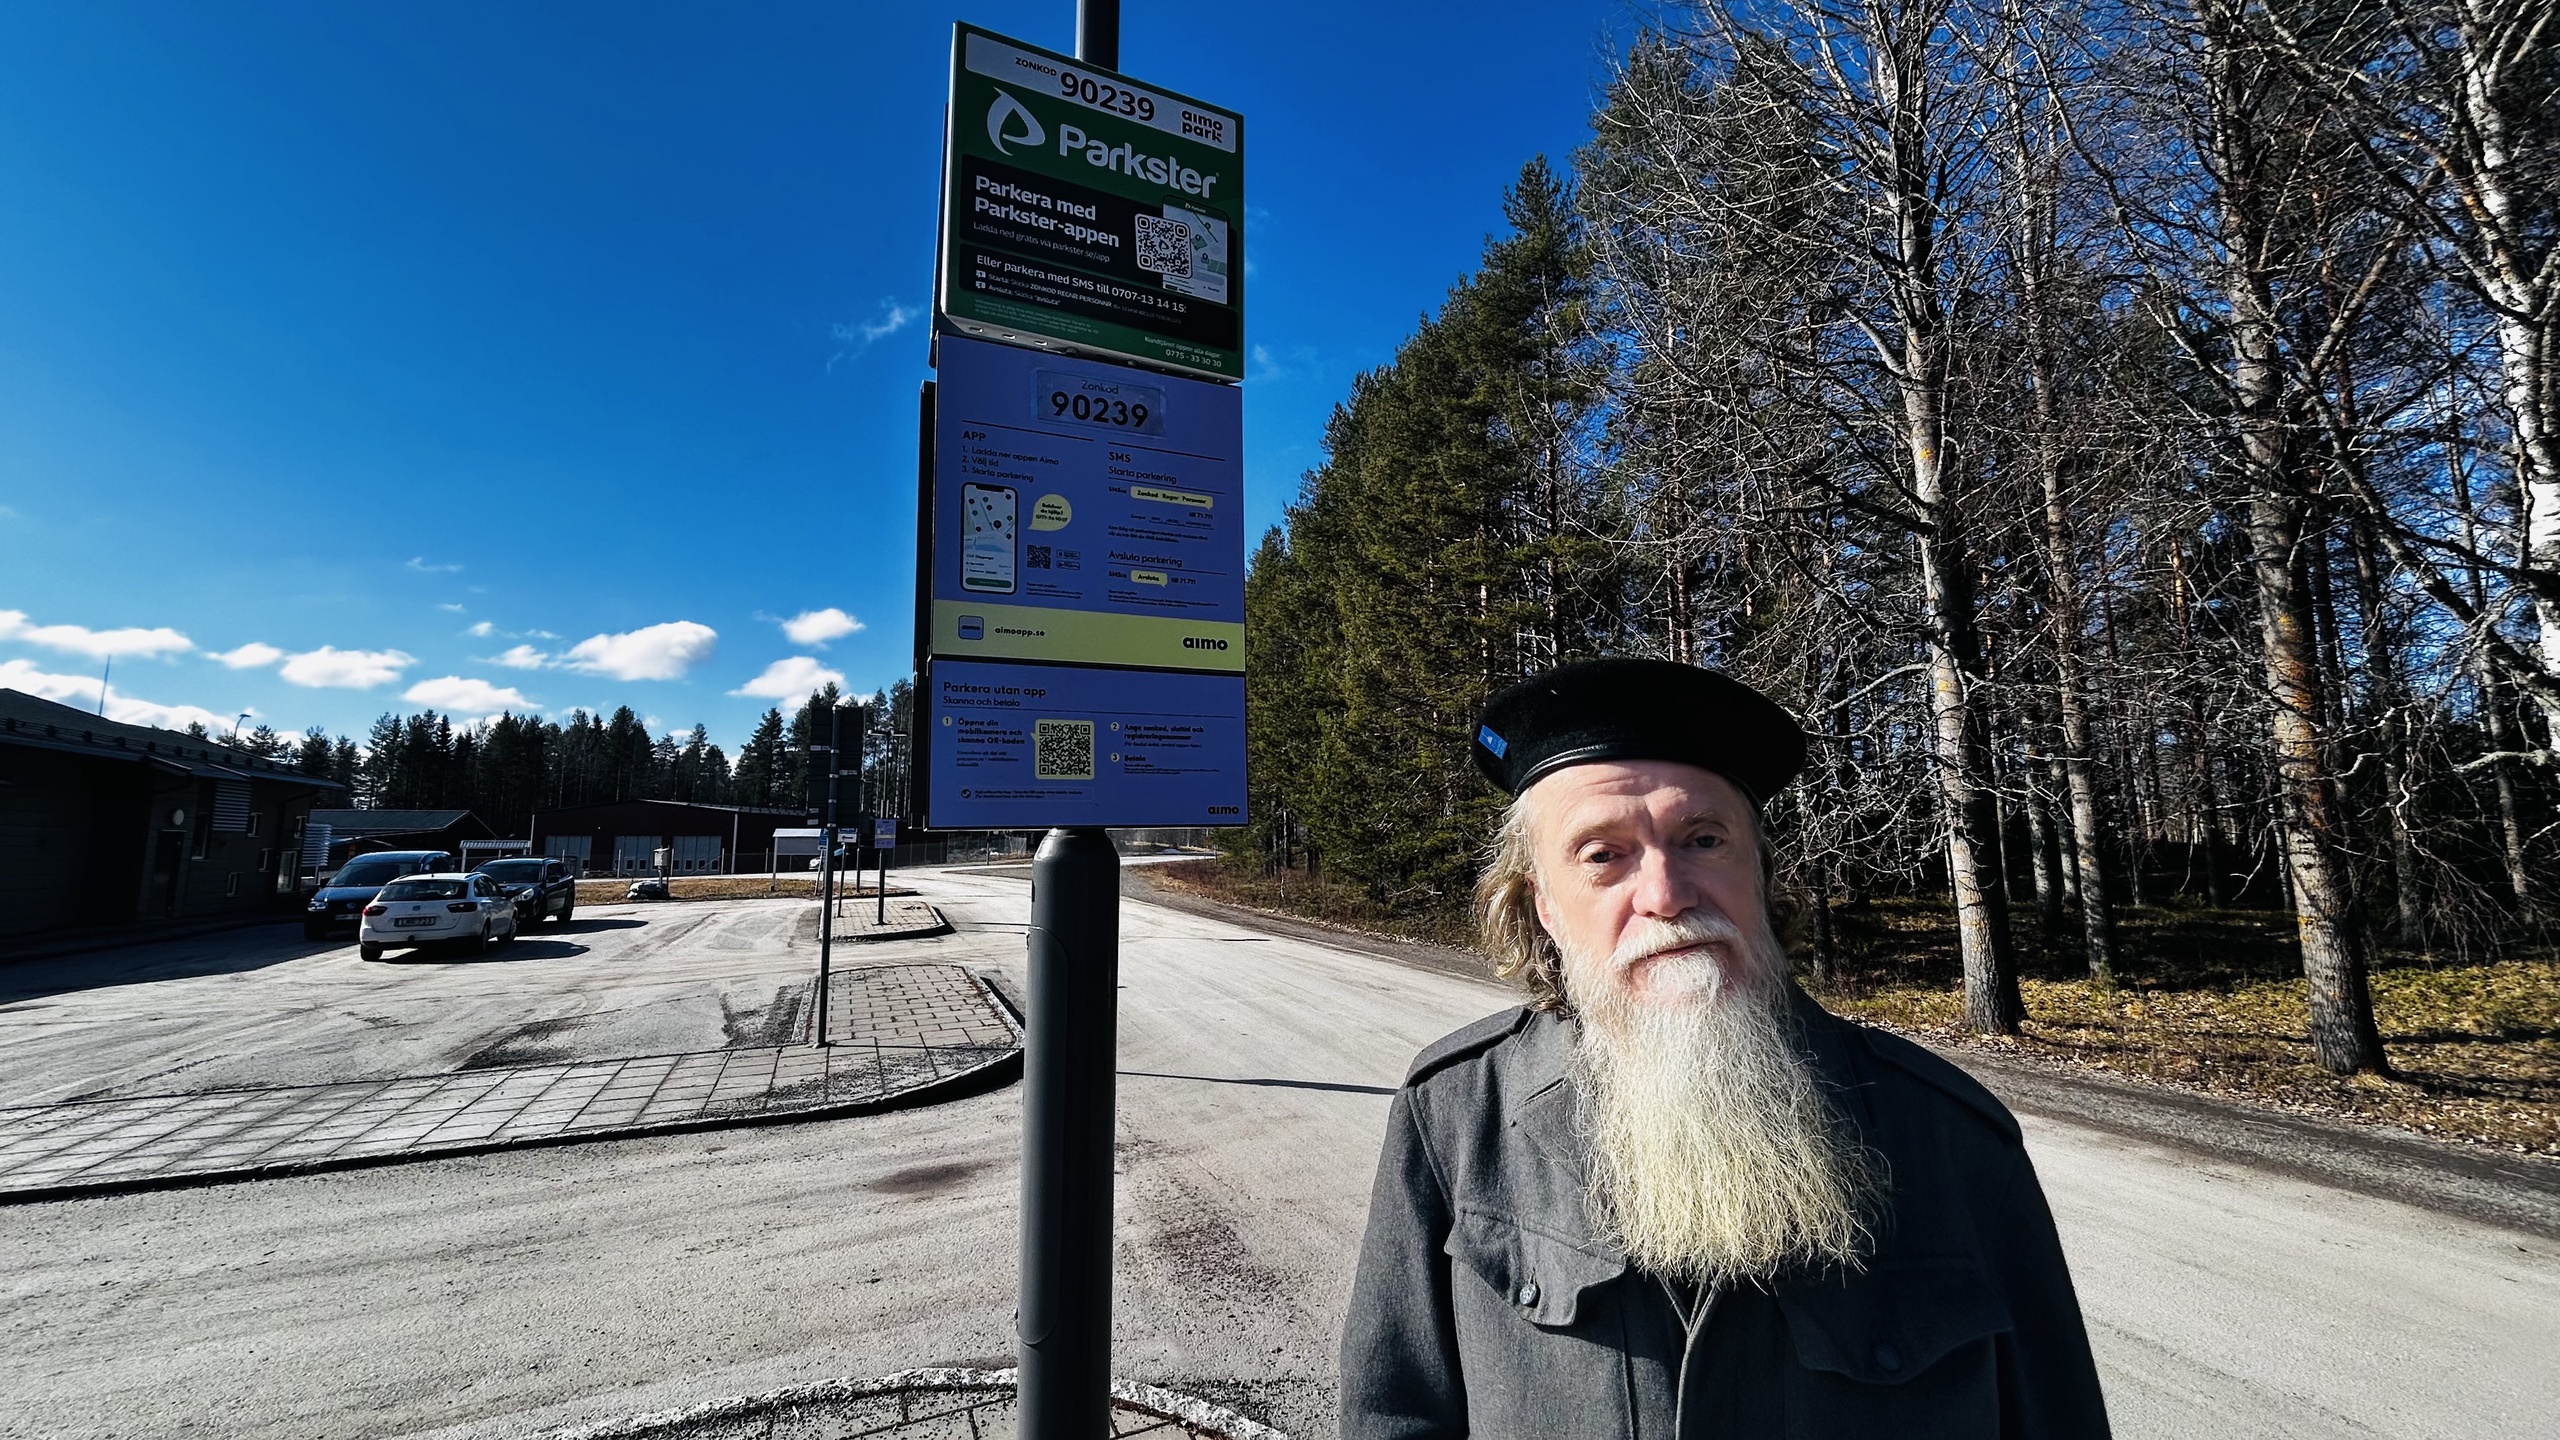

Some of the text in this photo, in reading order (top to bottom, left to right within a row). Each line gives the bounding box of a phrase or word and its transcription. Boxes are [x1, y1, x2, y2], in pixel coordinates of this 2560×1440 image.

[1015, 57, 1154, 121] ZONKOD 90239
[1182, 110, 1222, 131] aimo
[1182, 122, 1222, 144] park
[1060, 124, 1216, 198] Parkster
[976, 174, 1096, 220] Parkera med
[974, 196, 1120, 248] Parkster-appen
[974, 222, 998, 234] Ladda
[1000, 228, 1014, 238] ned
[1016, 234, 1038, 245] gratis
[1040, 239, 1051, 248] via
[976, 254, 1186, 313] Eller parkera med SMS till 0707-13 14 15:
[1166, 349, 1184, 359] 0775
[1201, 357, 1210, 365] 30
[1082, 380, 1119, 395] Zonkod
[1051, 391, 1148, 427] 90239
[962, 430, 986, 441] APP
[972, 447, 997, 456] Ladda
[1039, 456, 1059, 465] Aimo
[972, 456, 987, 466] Välj
[1108, 452, 1131, 463] SMS
[971, 467, 995, 476] Starta
[997, 471, 1034, 482] parkering
[1108, 466, 1177, 483] Starta parkering
[1137, 490, 1158, 498] Zonkod
[1108, 551, 1182, 567] Avsluta parkering
[995, 627, 1045, 637] aimoapp.se
[1182, 636, 1228, 651] aimo
[943, 682, 1046, 698] Parkera utan app
[943, 696, 1020, 707] Skanna och betala
[958, 717, 984, 726] Öppna
[1124, 724, 1141, 732] Ange
[1124, 733, 1192, 741] registreringsnummer
[1207, 804, 1239, 815] aimo
